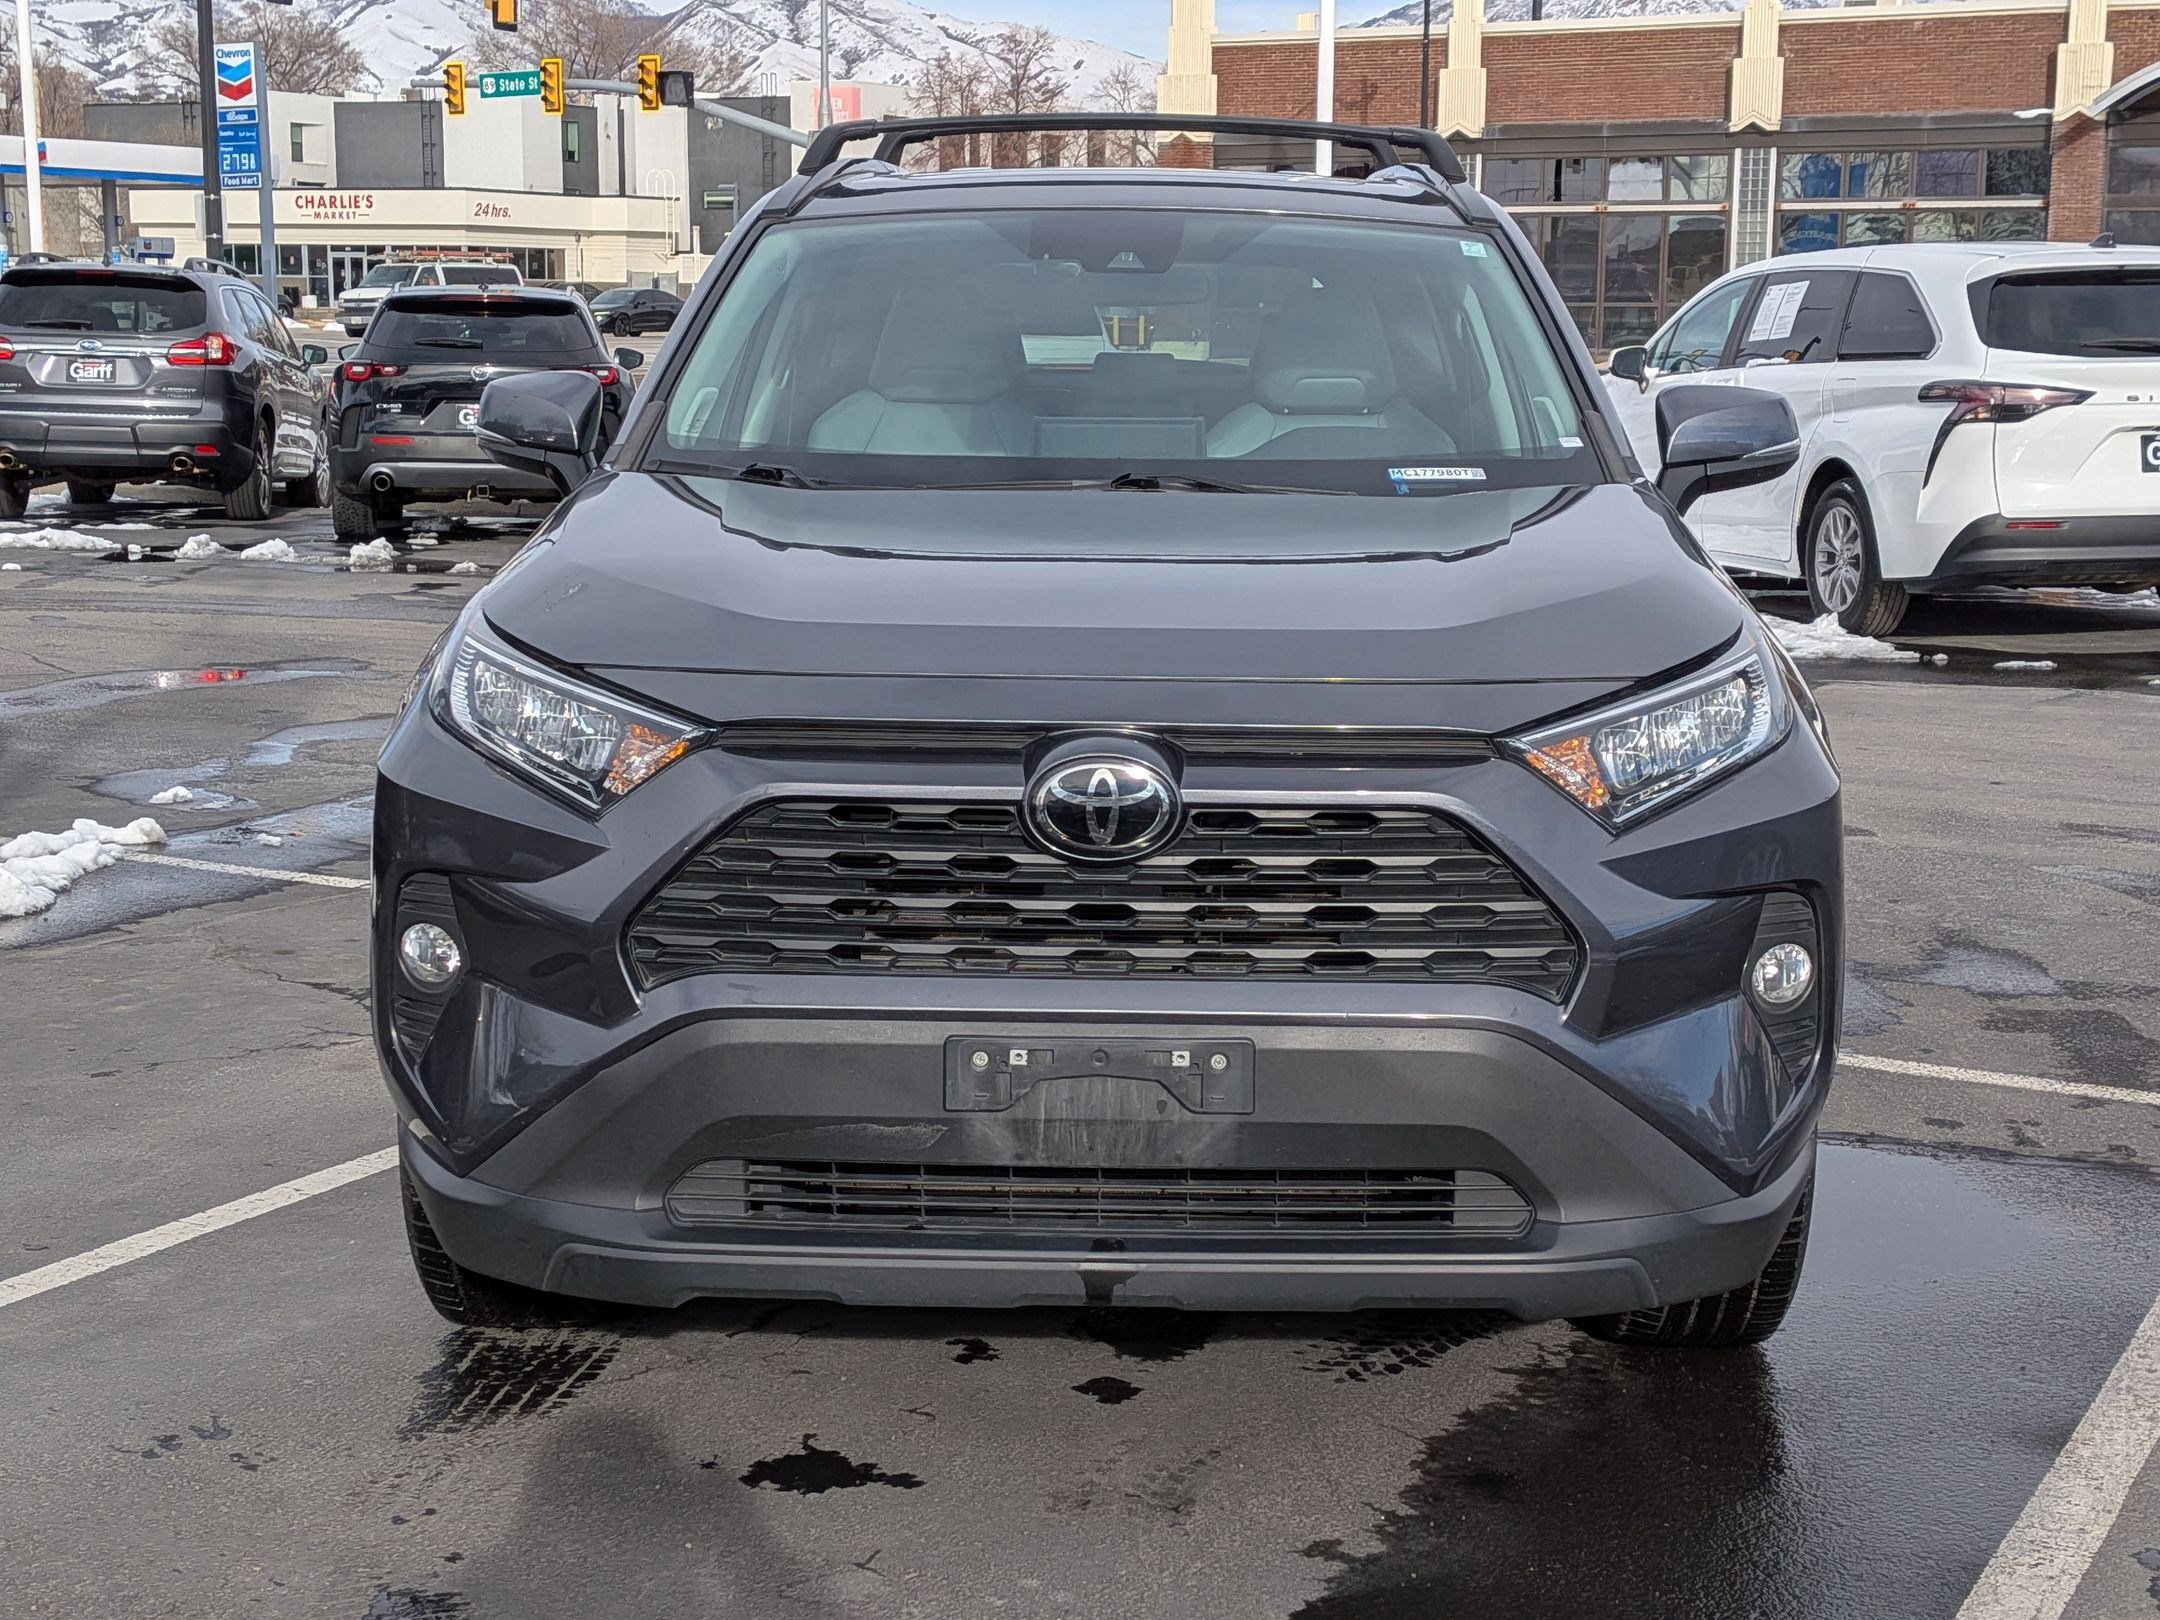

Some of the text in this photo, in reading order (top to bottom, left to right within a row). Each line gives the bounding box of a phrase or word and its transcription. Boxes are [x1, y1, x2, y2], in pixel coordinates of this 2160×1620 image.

[216, 48, 250, 59] Chevron
[499, 78, 525, 92] State
[528, 76, 538, 90] St
[223, 176, 258, 186] Food Mart
[295, 194, 374, 209] CHARLIE'S
[313, 211, 357, 220] MARKET
[474, 202, 511, 218] 24 hrs.
[70, 362, 113, 379] Garff
